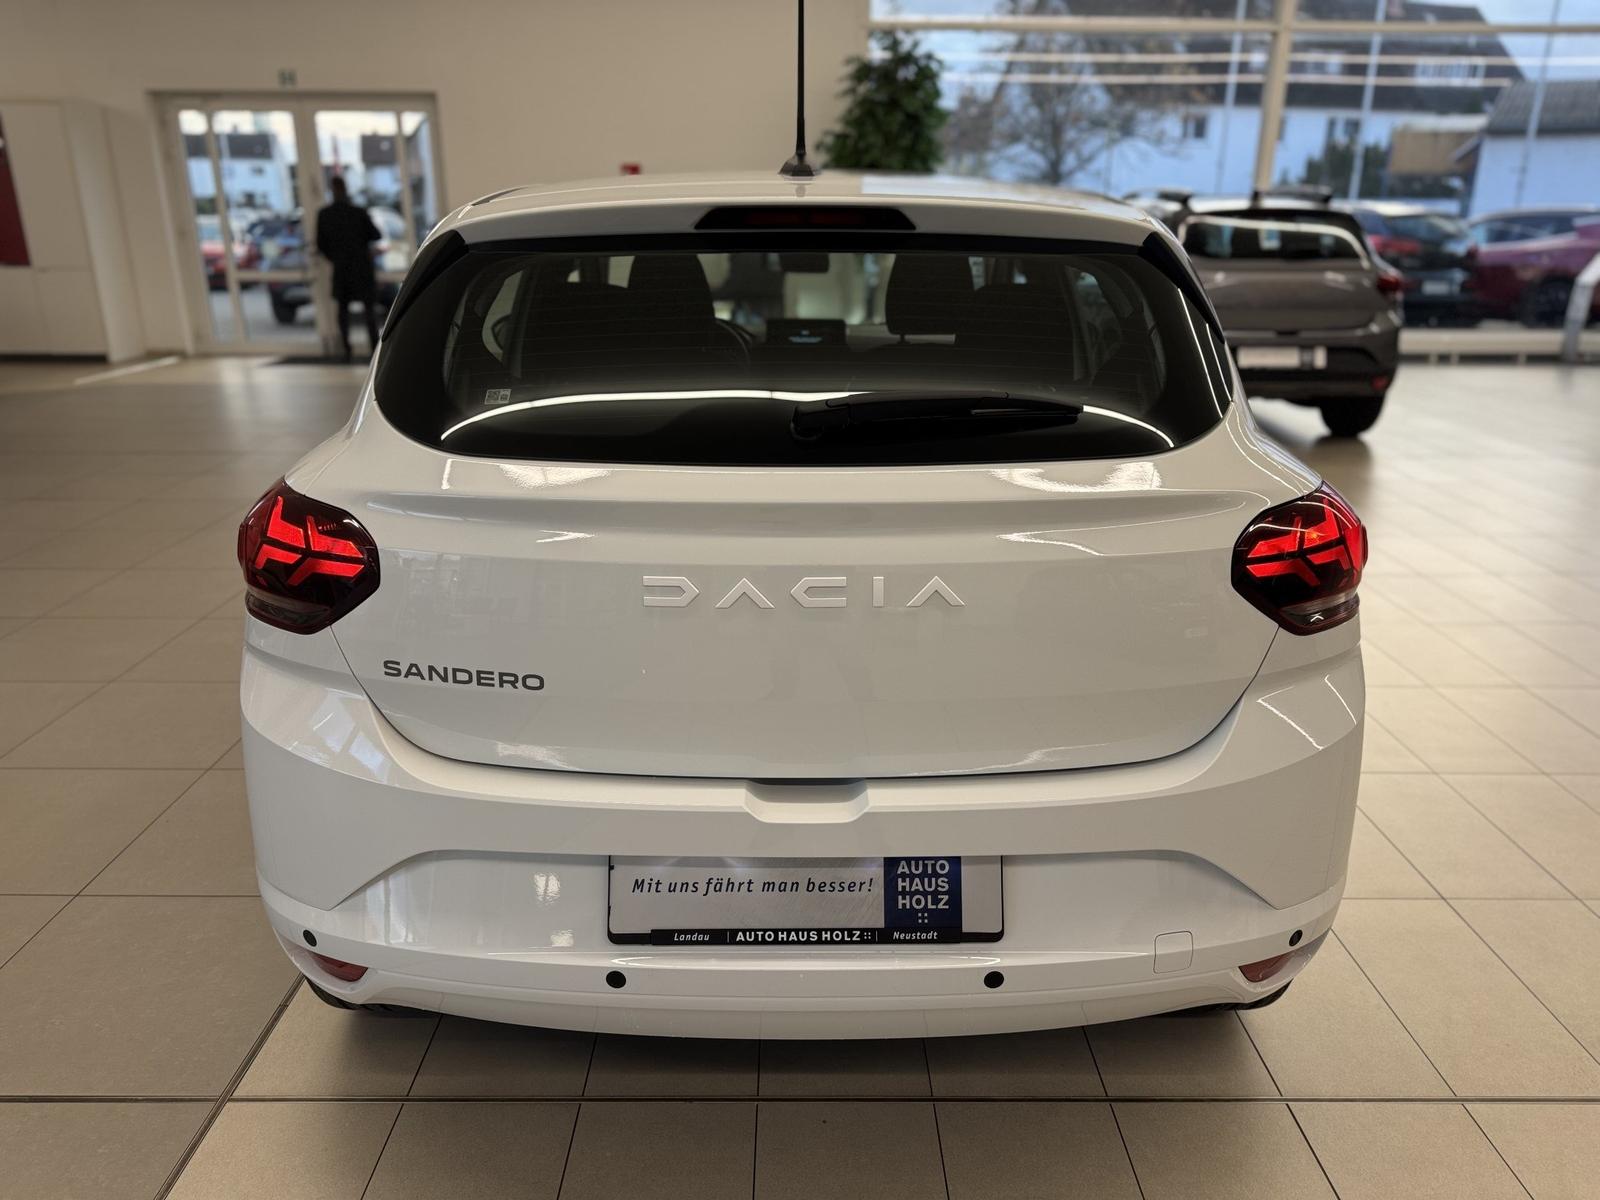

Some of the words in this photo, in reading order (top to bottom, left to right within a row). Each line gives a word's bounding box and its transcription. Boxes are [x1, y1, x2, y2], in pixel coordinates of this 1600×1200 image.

[642, 576, 966, 609] DACIA
[383, 660, 545, 691] SANDERO
[897, 860, 950, 875] AUTO
[632, 878, 662, 893] Mit
[668, 880, 699, 893] uns
[703, 877, 754, 896] fährt
[761, 879, 800, 893] man
[806, 877, 873, 893] besser!
[897, 877, 950, 892] HAUS
[897, 895, 950, 909] HOLZ
[673, 932, 710, 942] Landau
[822, 930, 861, 941] HOLZ
[892, 930, 938, 941] Neustadt
